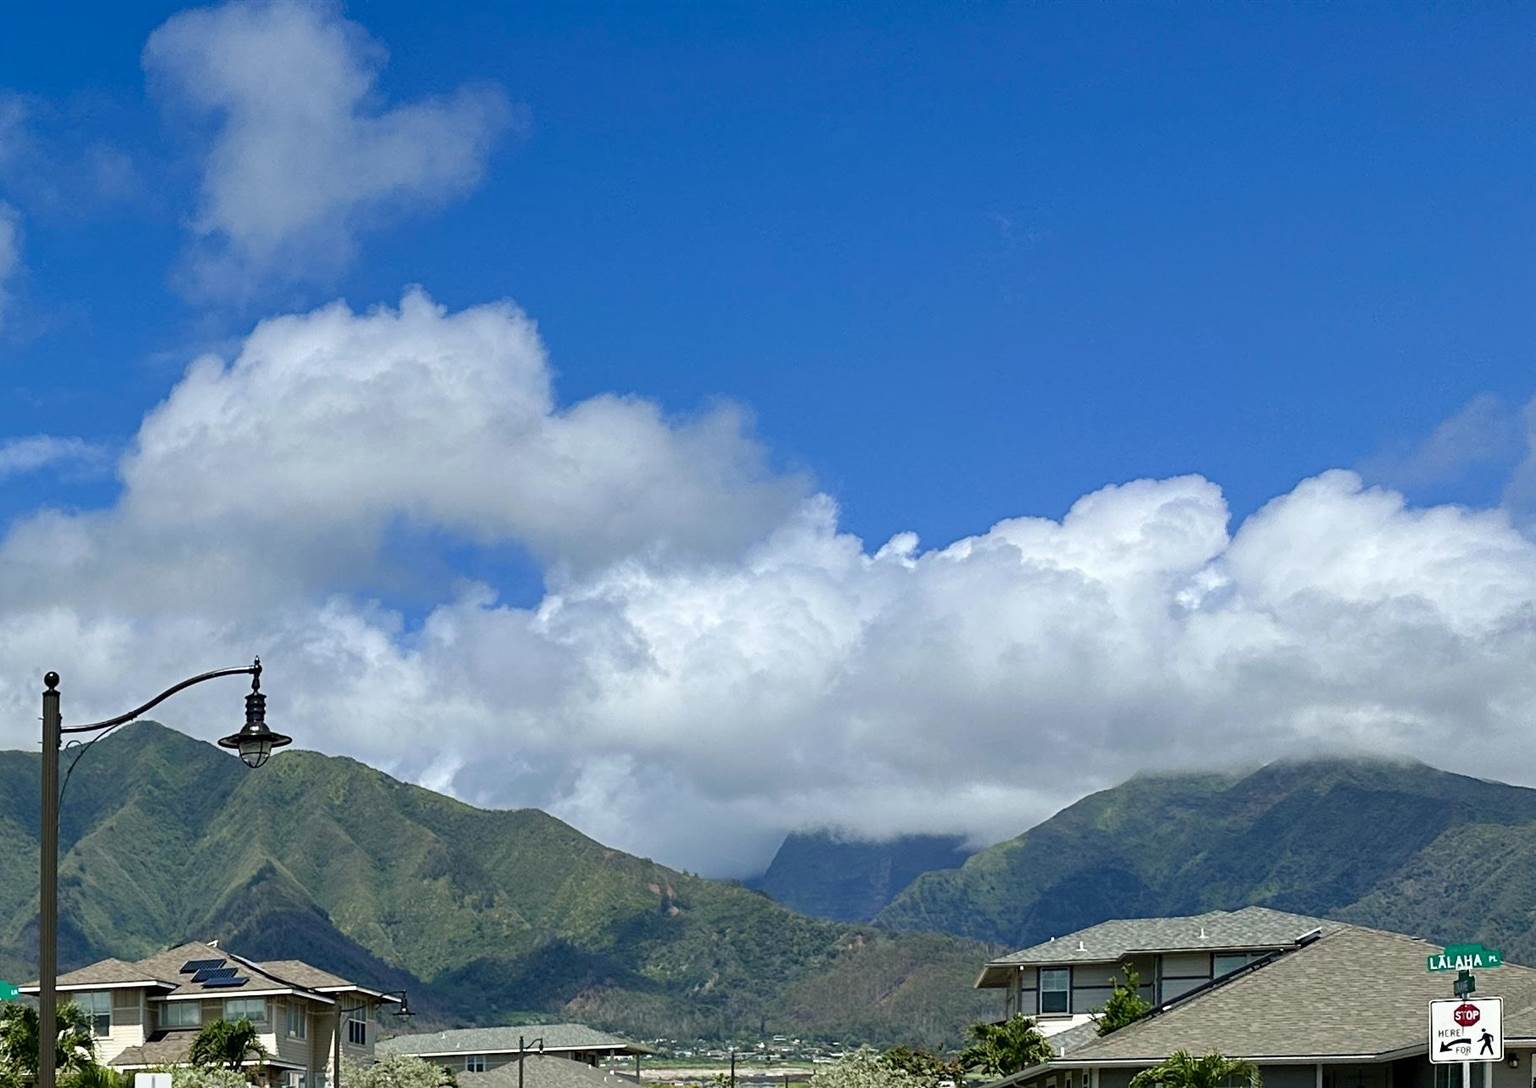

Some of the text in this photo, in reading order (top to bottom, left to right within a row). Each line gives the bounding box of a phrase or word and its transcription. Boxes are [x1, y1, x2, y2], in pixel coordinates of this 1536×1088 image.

[1488, 955, 1498, 963] PL
[1455, 1010, 1480, 1021] STOP
[1438, 1029, 1461, 1038] HERE
[1455, 1046, 1472, 1054] FOR
